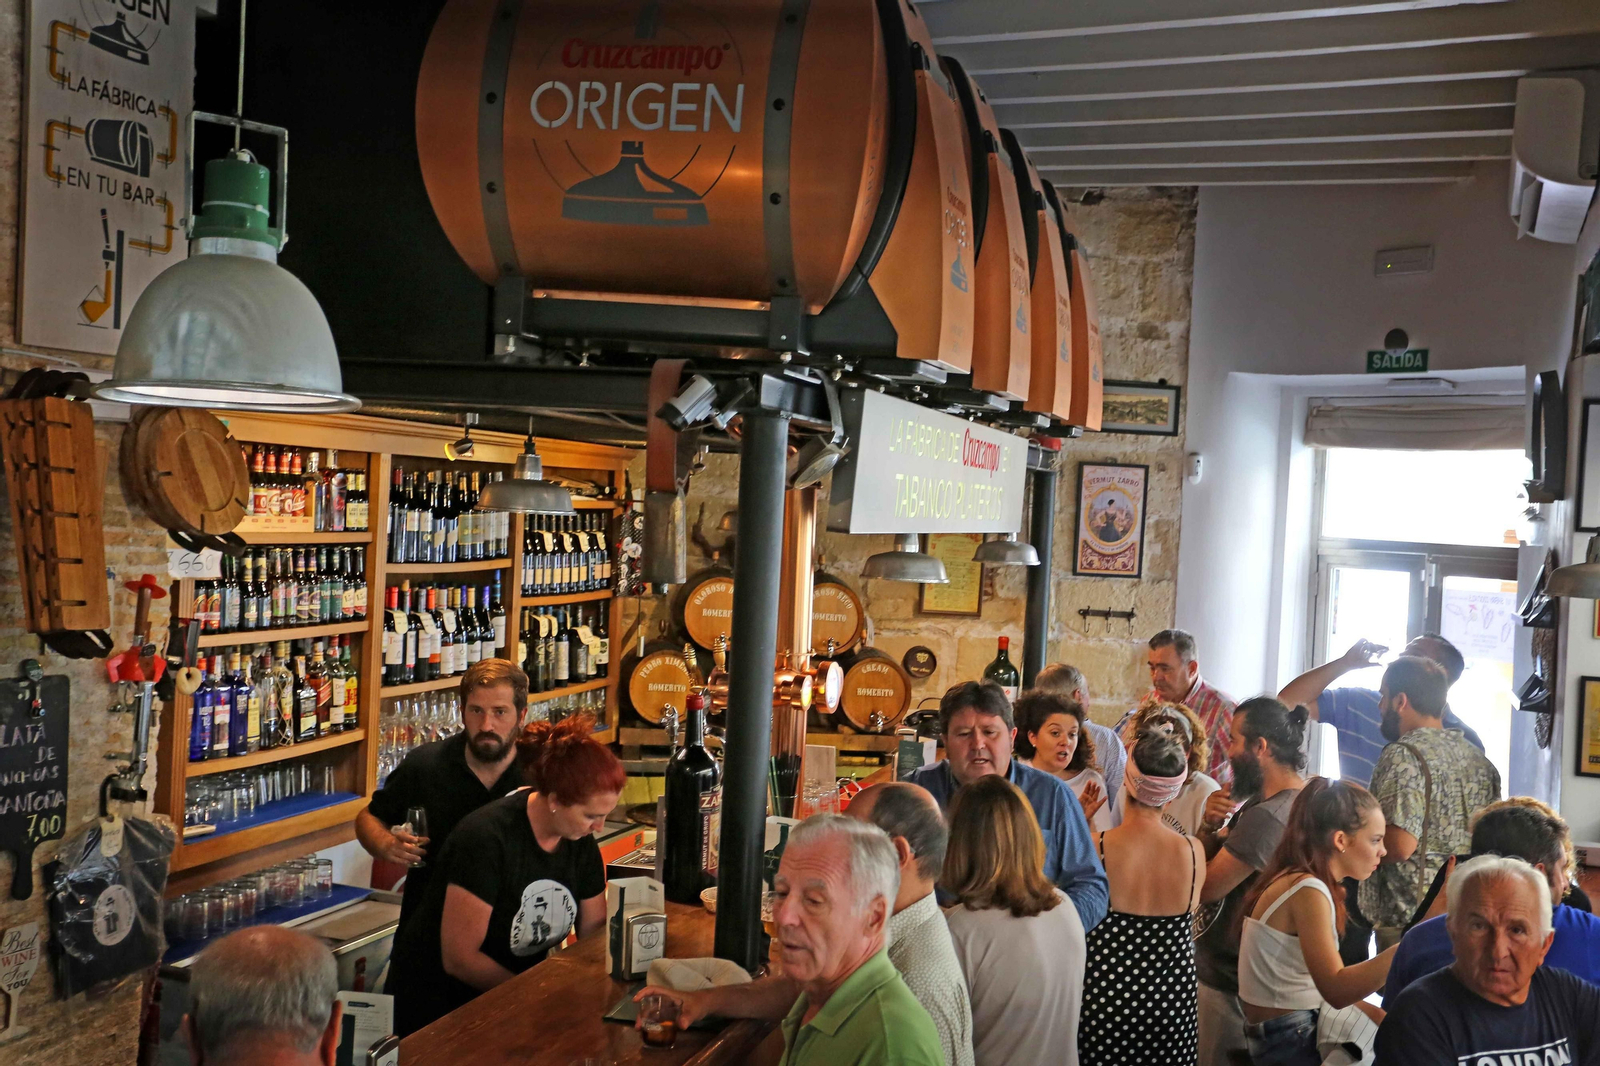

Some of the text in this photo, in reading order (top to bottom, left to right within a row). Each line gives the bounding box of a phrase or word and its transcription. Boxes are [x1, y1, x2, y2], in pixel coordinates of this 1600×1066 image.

[562, 37, 724, 77] Cruzcampo
[67, 72, 158, 119] LA FÁBRICA
[530, 80, 745, 133] ORIGEN
[67, 166, 156, 207] EN TU BAR
[1372, 353, 1423, 369] SALIDA
[889, 416, 904, 454] LA
[948, 431, 960, 463] DE
[962, 427, 1001, 479] Cruzcampo
[1089, 476, 1140, 487] VERMUT ZARRO
[894, 473, 1004, 521] TABANCO PLATEROS
[693, 583, 726, 605] OLOROSO
[836, 591, 853, 610] SECO
[702, 608, 733, 618] ROMERI
[639, 656, 690, 680] PEDRO XIME
[861, 663, 890, 674] CREAM
[648, 682, 687, 693] ROMERITO
[856, 687, 894, 698] ROMERITO
[35, 745, 57, 764] DE
[0, 764, 60, 787] NCHOAS
[0, 930, 39, 955] Best
[1, 949, 37, 968] WINE
[2, 962, 30, 983] For
[6, 978, 28, 991] YOU
[1458, 1042, 1572, 1066] NDON
